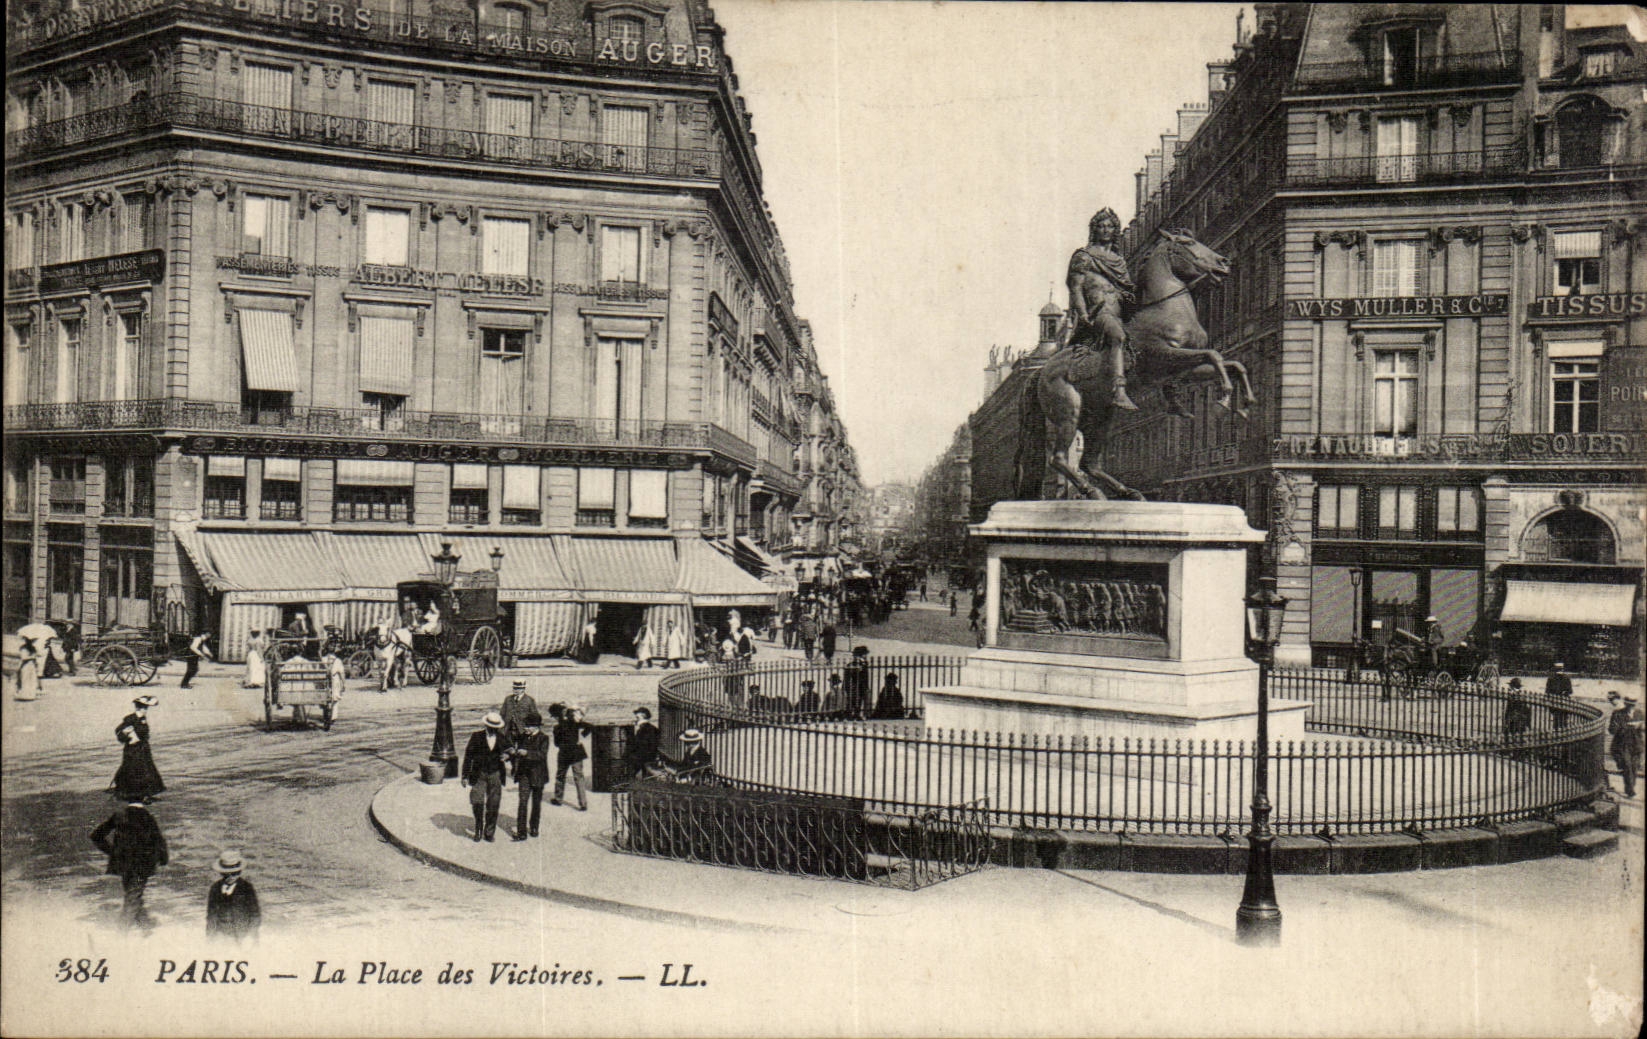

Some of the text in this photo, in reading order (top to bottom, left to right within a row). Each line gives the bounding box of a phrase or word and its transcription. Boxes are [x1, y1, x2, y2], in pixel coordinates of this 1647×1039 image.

[398, 20, 429, 39] DE
[444, 27, 473, 45] LA
[491, 31, 578, 57] MAISON
[597, 38, 716, 67] AUGER
[1296, 300, 1344, 317] WYS
[1353, 298, 1446, 317] MULLER
[1450, 299, 1463, 313] &
[1536, 293, 1647, 316] TISSUS
[397, 444, 490, 461] AUGER
